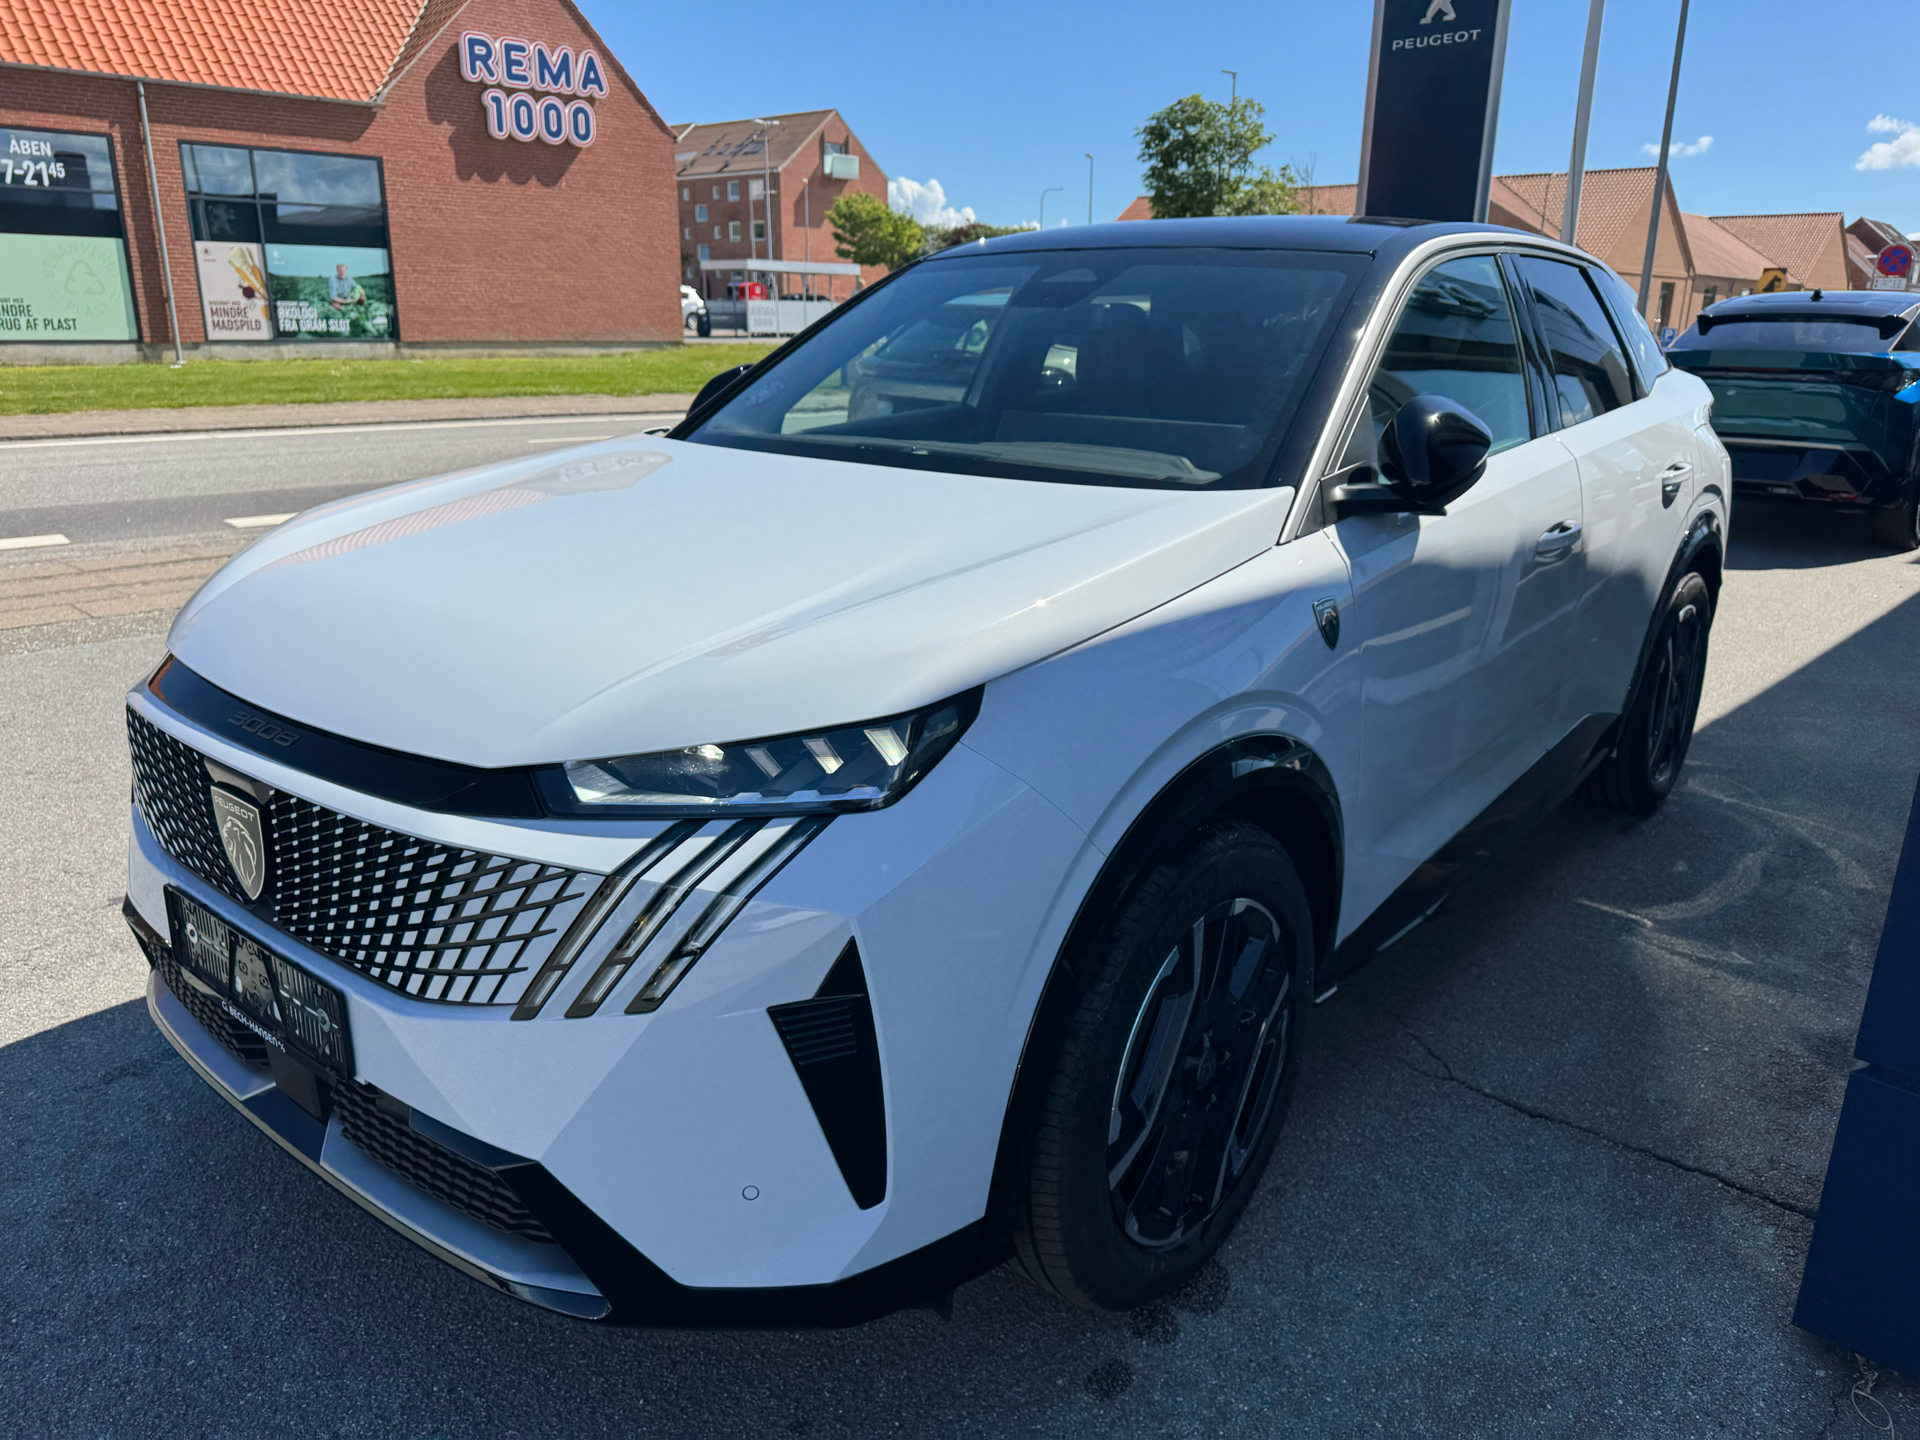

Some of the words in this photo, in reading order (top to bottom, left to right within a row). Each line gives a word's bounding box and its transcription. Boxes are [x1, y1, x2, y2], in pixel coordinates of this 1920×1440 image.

[1392, 29, 1481, 51] PEUGEOT
[459, 30, 610, 99] REMA
[481, 88, 597, 148] 1000
[9, 134, 52, 157] ÅBEN
[0, 304, 33, 317] NDRE
[209, 306, 249, 318] MINDRE
[277, 306, 318, 319] ØKOLOGI
[26, 318, 39, 331] AF
[43, 318, 78, 331] PLAST
[211, 318, 261, 331] MADSPILD
[279, 318, 299, 332] FRA
[328, 319, 350, 332] SLOT
[227, 711, 301, 747] 3008
[214, 795, 255, 822] PEUGEOT
